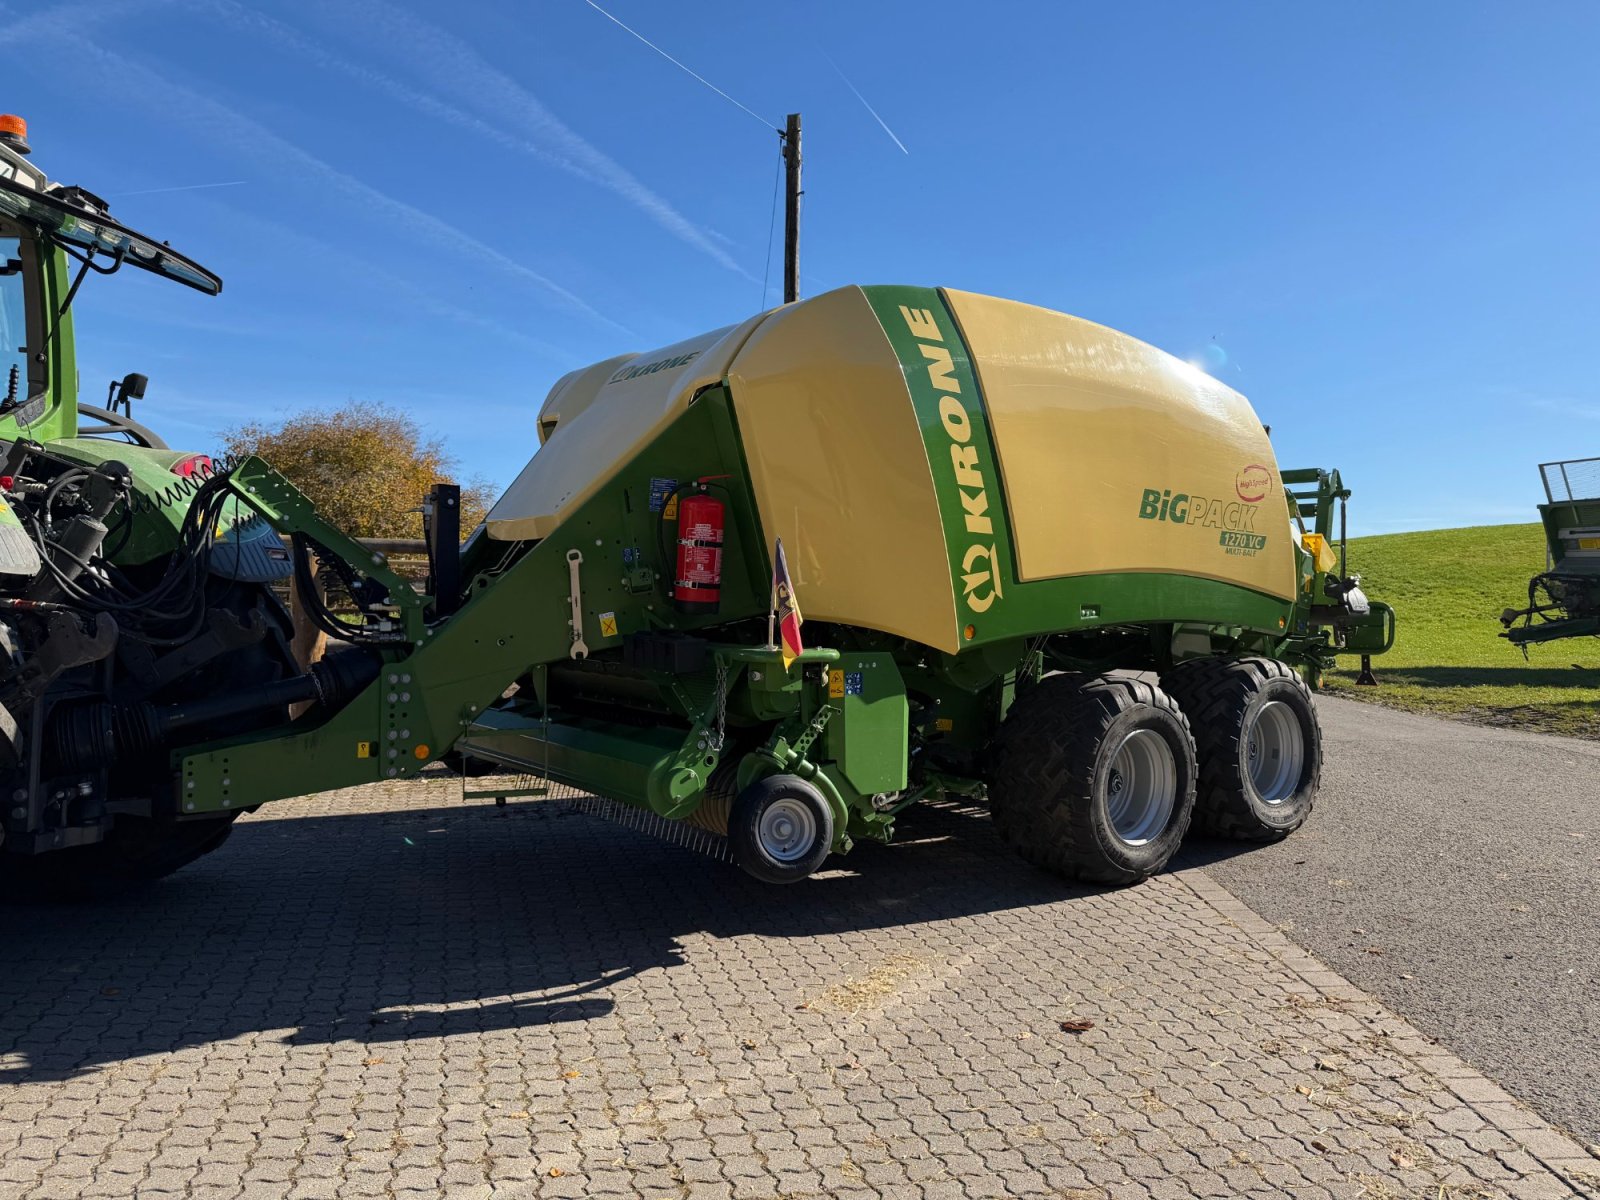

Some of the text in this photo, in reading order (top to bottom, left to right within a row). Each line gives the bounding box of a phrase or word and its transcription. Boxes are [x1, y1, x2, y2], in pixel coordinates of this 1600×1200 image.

[899, 305, 993, 534] KRONE
[1223, 531, 1262, 549] 1270 VC
